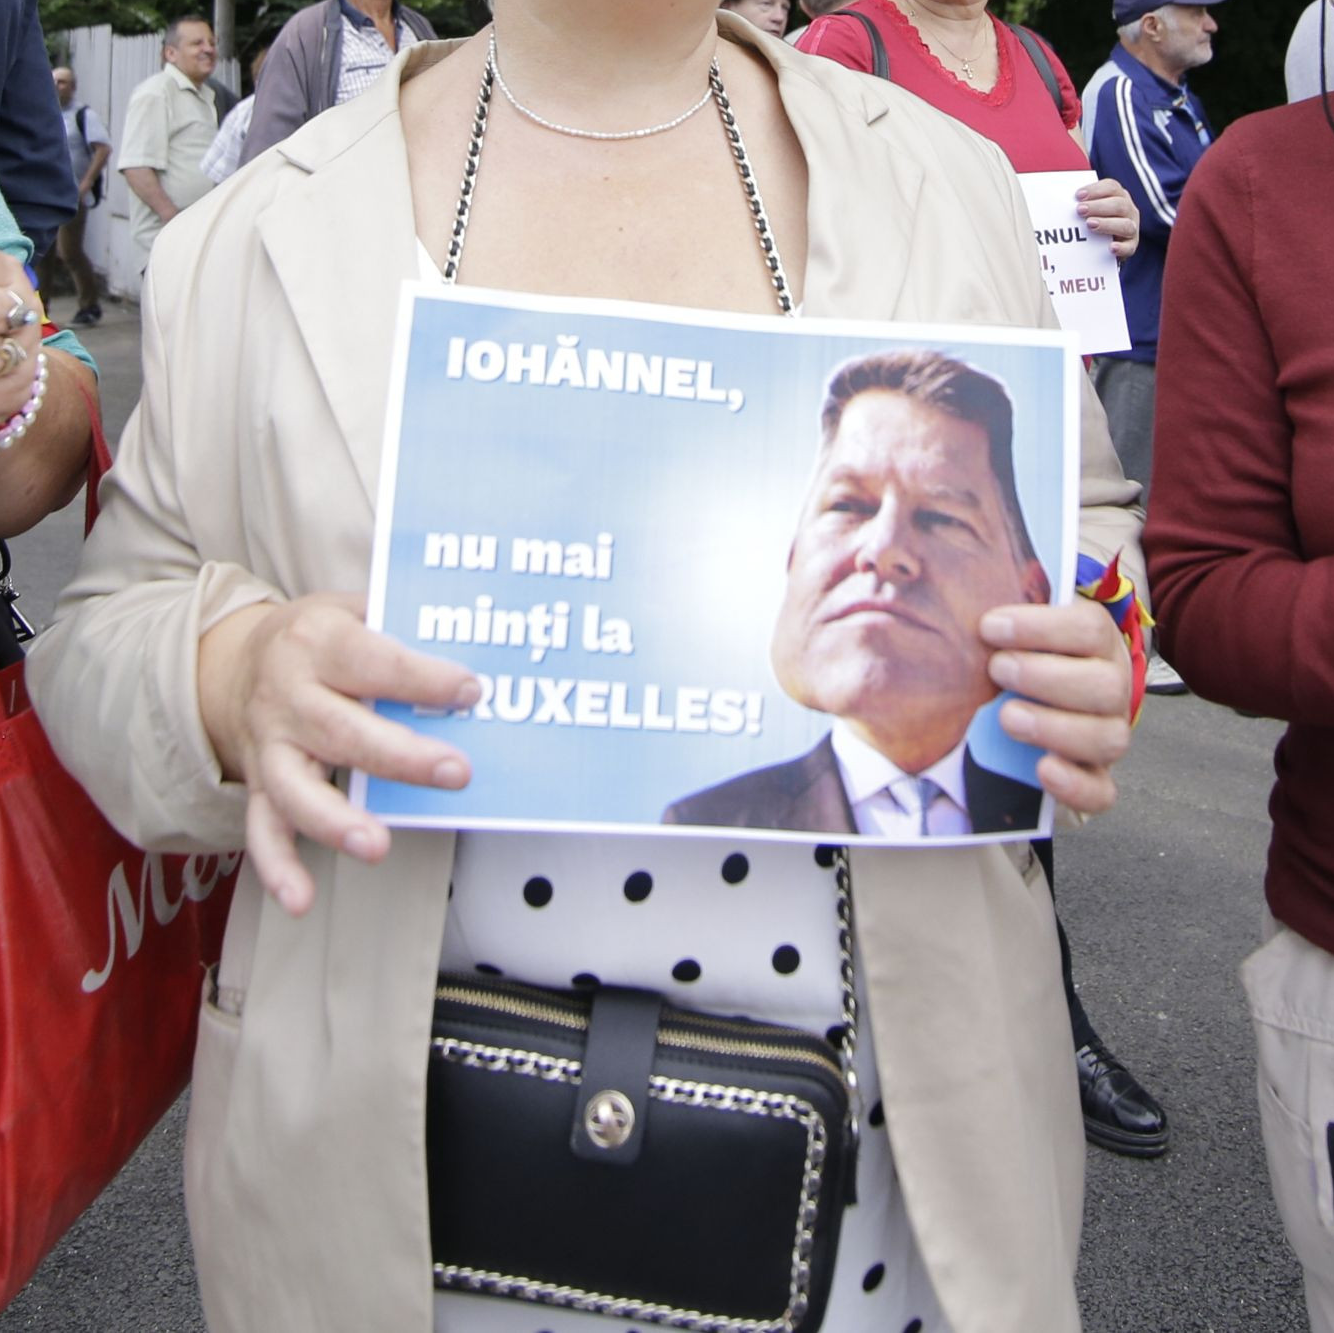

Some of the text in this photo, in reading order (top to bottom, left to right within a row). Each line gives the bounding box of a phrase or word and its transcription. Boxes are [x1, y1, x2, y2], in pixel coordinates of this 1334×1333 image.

[1059, 276, 1106, 294] MEU!
[446, 336, 745, 413] IOHĂNNEL,
[423, 532, 613, 579] nu mai
[583, 605, 633, 654] la
